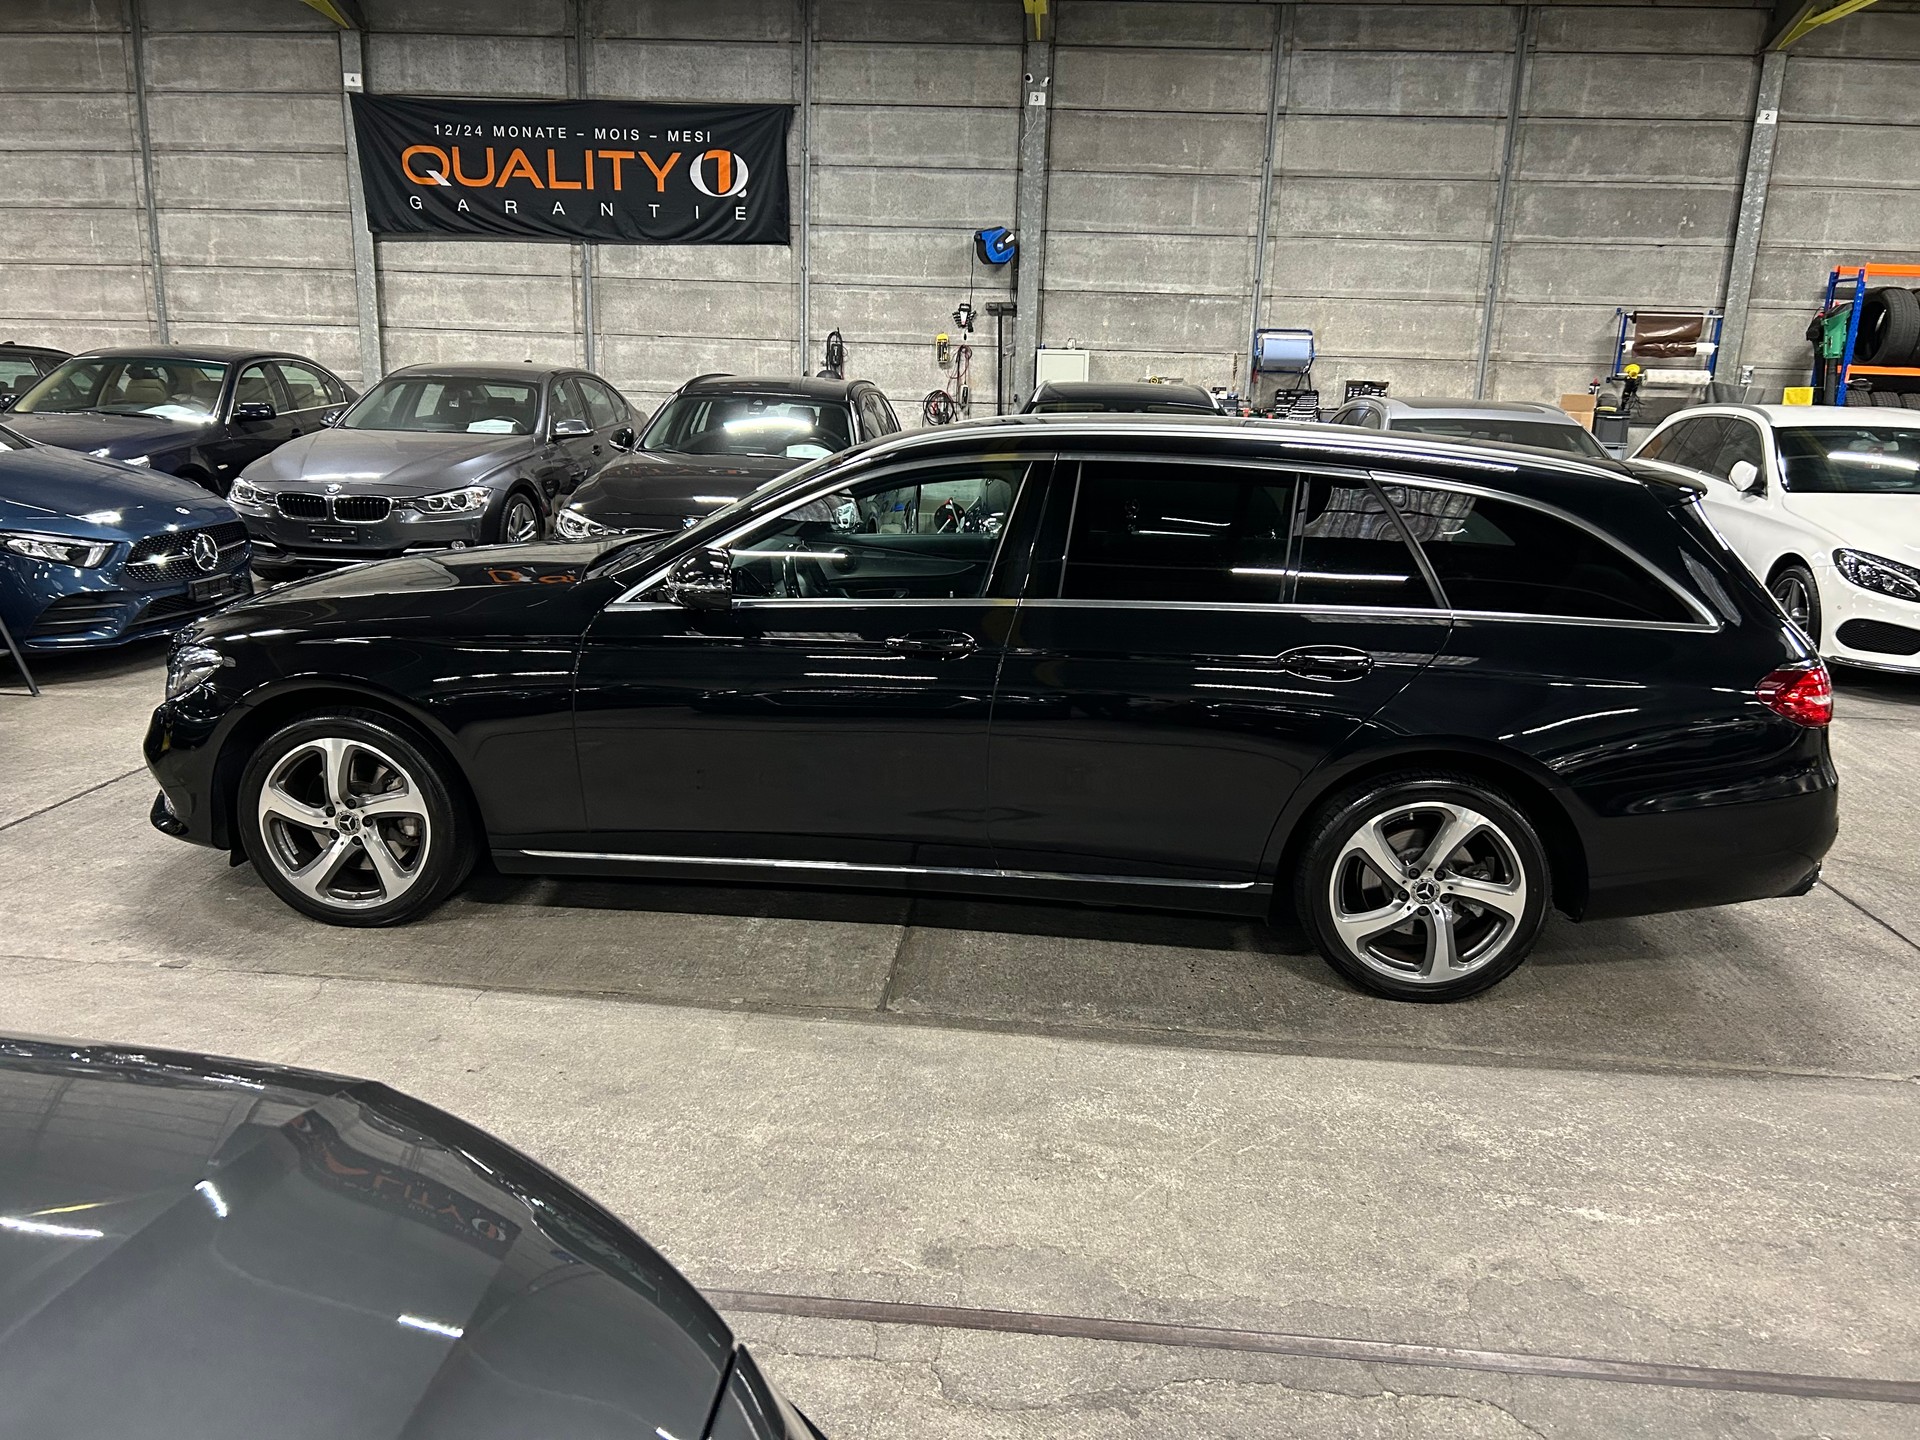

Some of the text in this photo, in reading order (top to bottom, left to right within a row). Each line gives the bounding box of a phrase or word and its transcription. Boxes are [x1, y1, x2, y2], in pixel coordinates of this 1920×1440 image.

[433, 124, 483, 137] 12/24
[493, 125, 567, 139] MONATE
[594, 127, 640, 141] MOIS
[667, 130, 711, 143] MESI
[401, 144, 682, 193] QUALITY
[409, 195, 747, 221] GARANTIE
